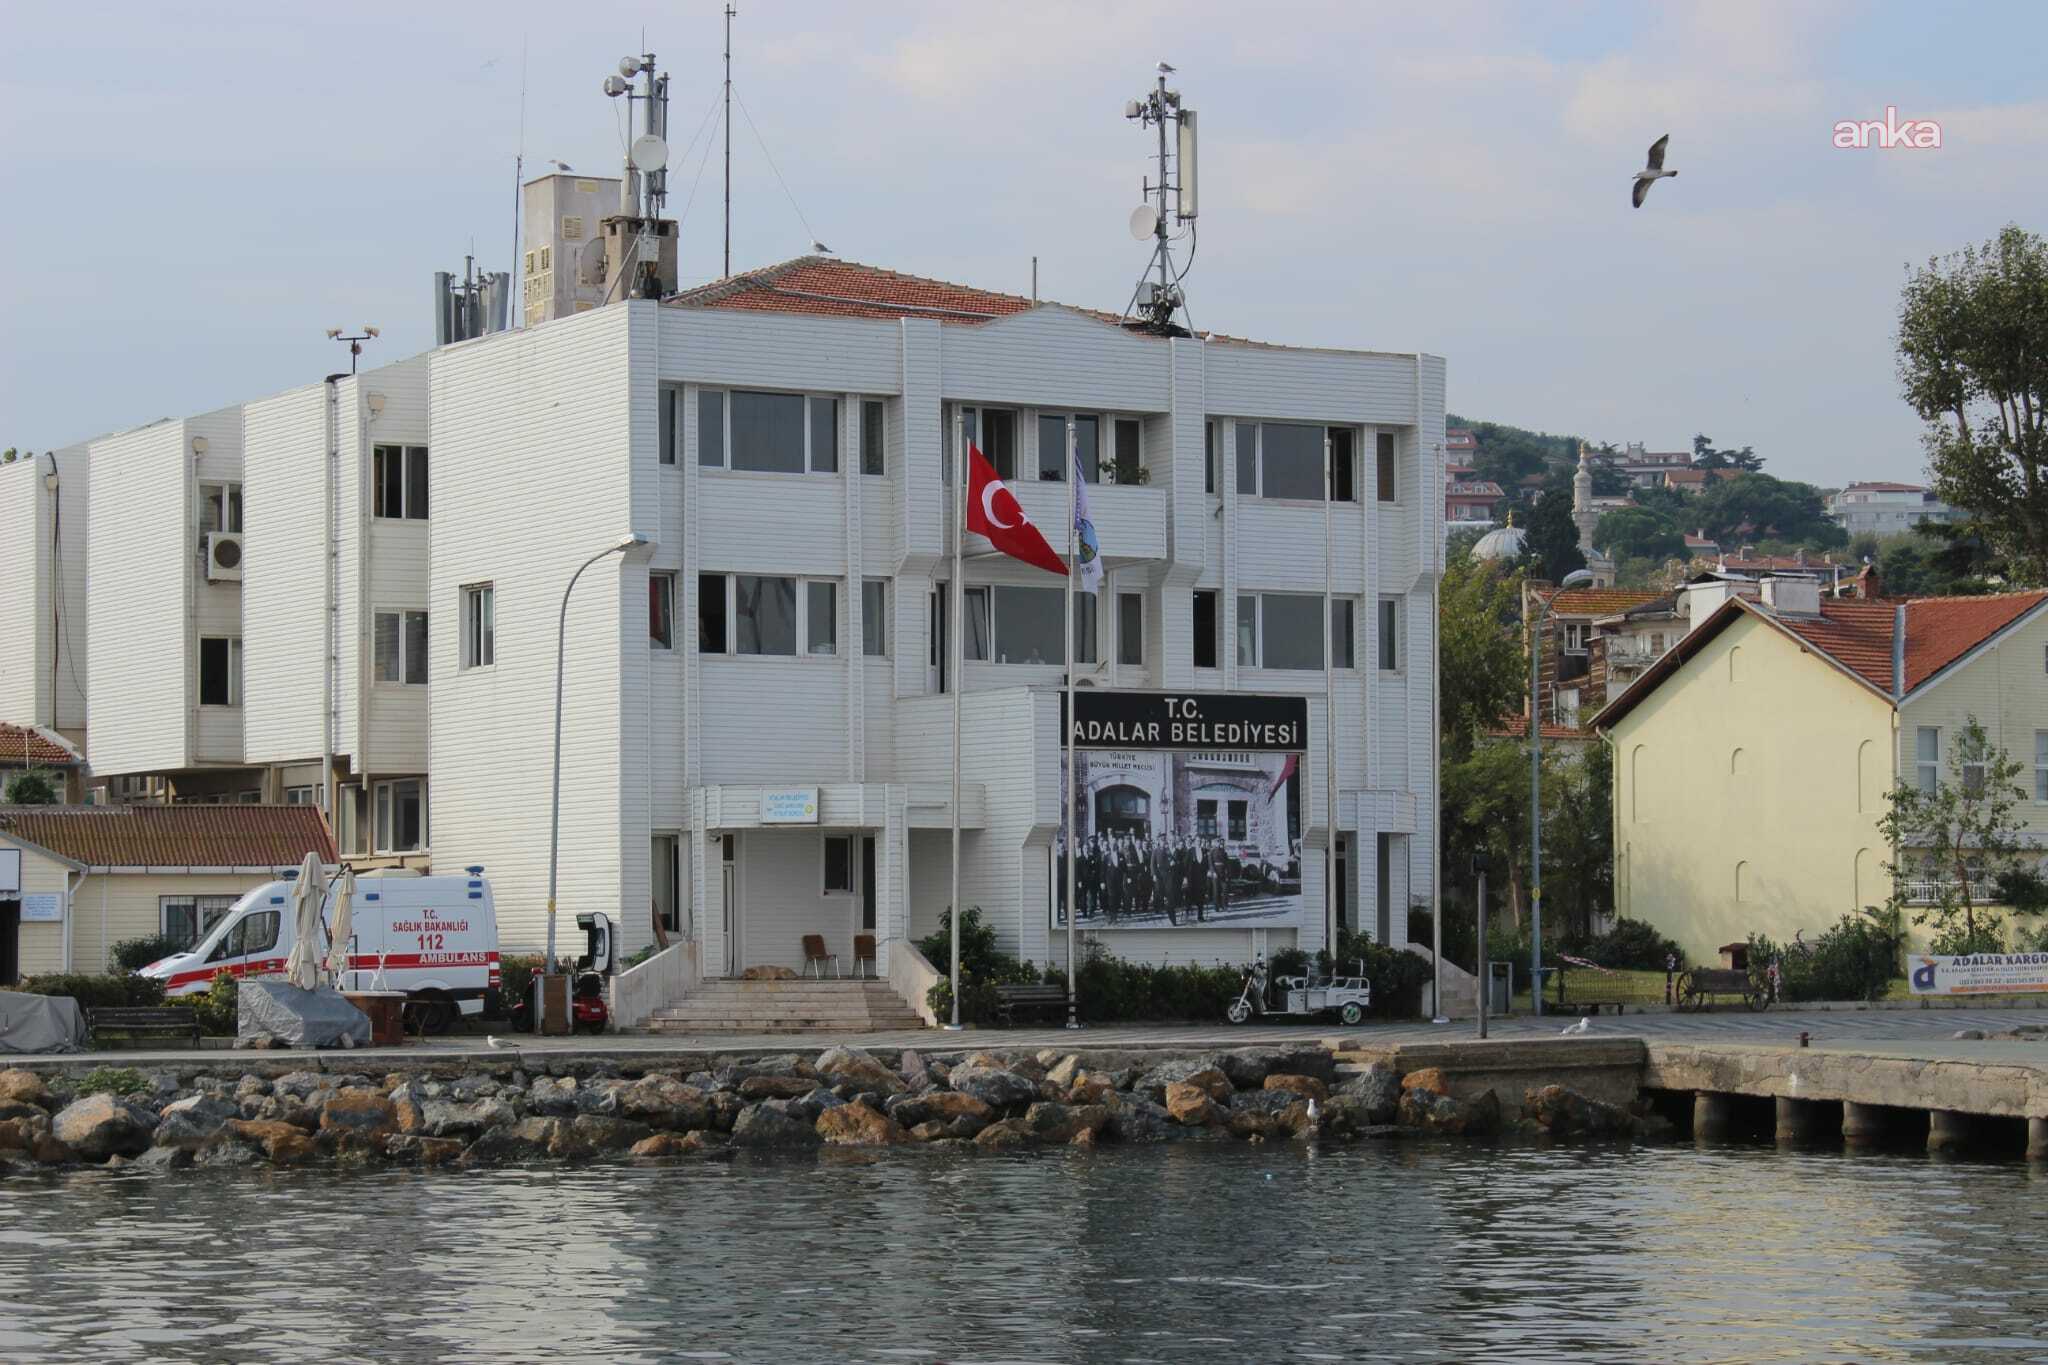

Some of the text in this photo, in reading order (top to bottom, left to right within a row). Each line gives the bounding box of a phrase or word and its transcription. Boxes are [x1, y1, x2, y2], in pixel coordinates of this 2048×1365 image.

[1164, 698, 1203, 719] T.C.
[1073, 719, 1298, 744] ADALAR BELEDİYESİ
[423, 909, 438, 920] T.C.
[393, 920, 468, 932] SAĞLIK BAKANLIĞI
[417, 934, 444, 950] 112
[419, 952, 486, 964] AMBULANS
[1952, 954, 2048, 967] ADALAR KARGO
